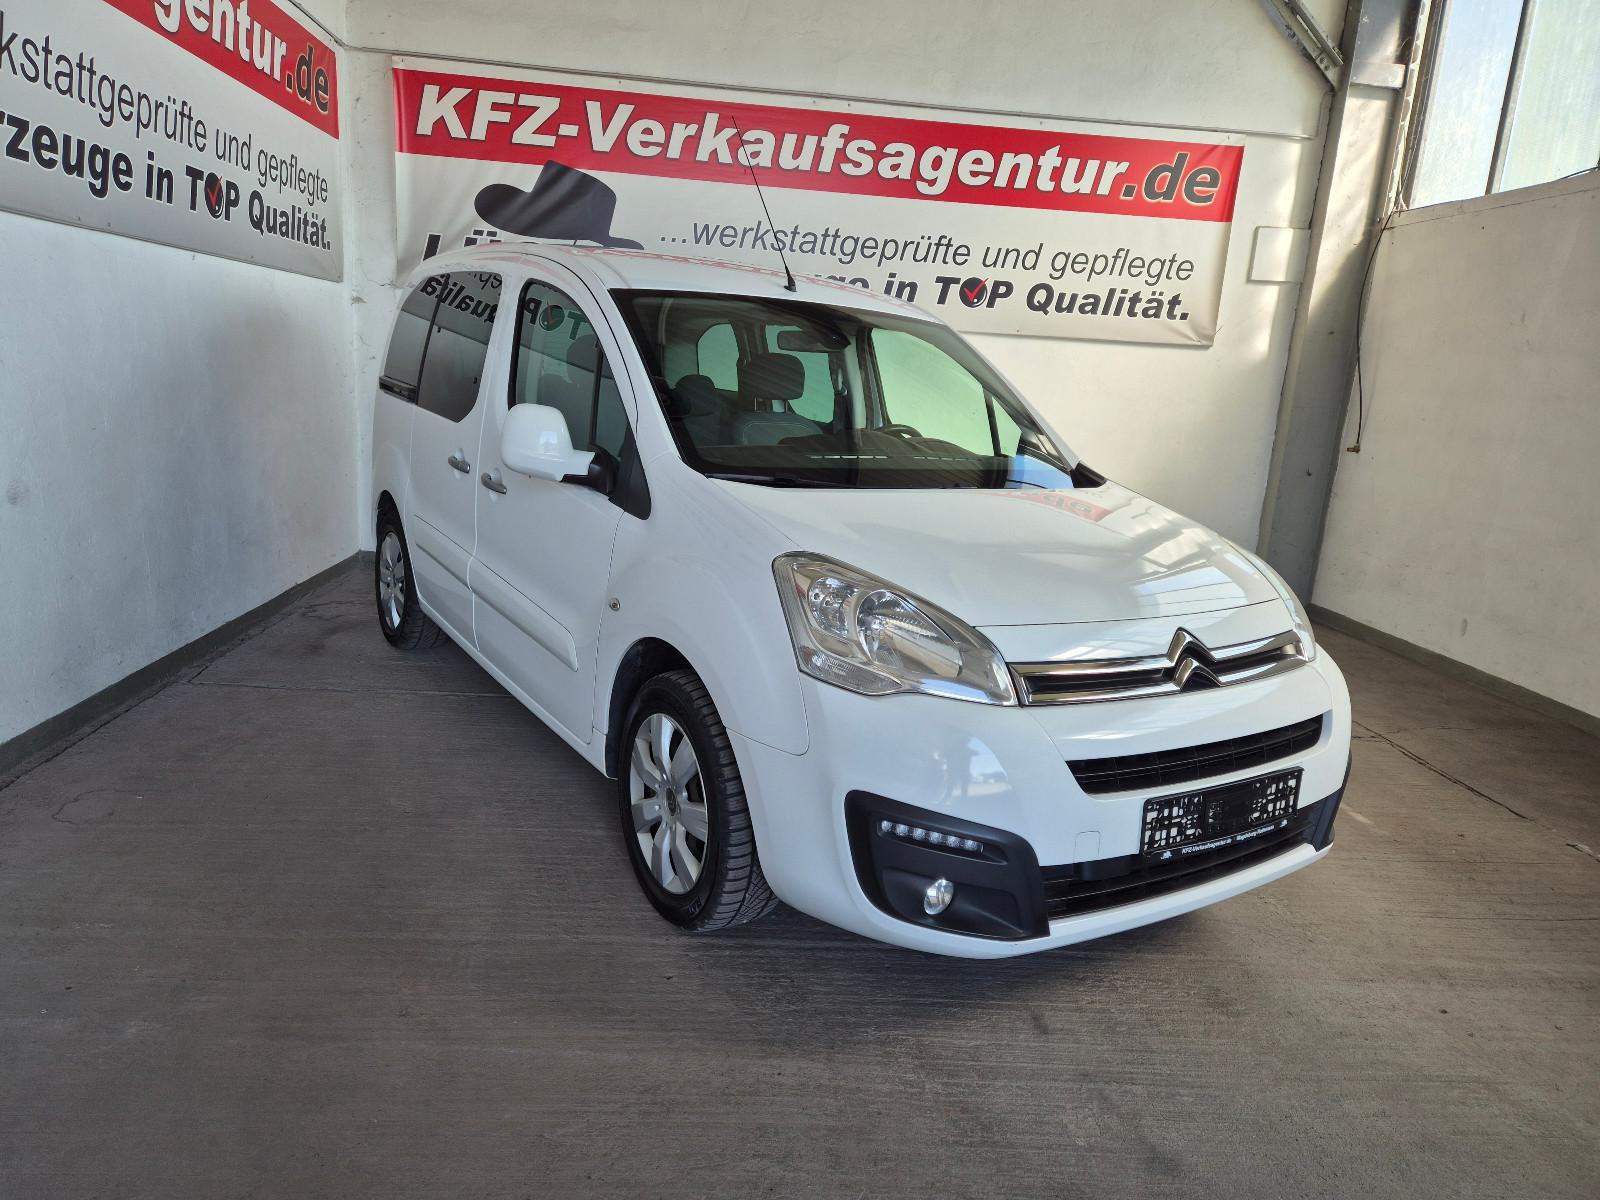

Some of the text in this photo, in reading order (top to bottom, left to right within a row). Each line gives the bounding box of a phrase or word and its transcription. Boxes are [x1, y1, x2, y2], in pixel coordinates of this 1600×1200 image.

[216, 129, 251, 171] und
[258, 149, 328, 206] gepflegte
[416, 84, 1221, 204] KFZ-Verkaufsagentur.de
[146, 151, 174, 204] in
[186, 165, 240, 220] TOP
[249, 190, 331, 250] Qualität.
[660, 221, 1195, 285] ...werkstattgeprüfte und gepflegte
[884, 273, 918, 302] in
[935, 276, 1013, 308] TOP
[1026, 283, 1189, 321] Qualität.
